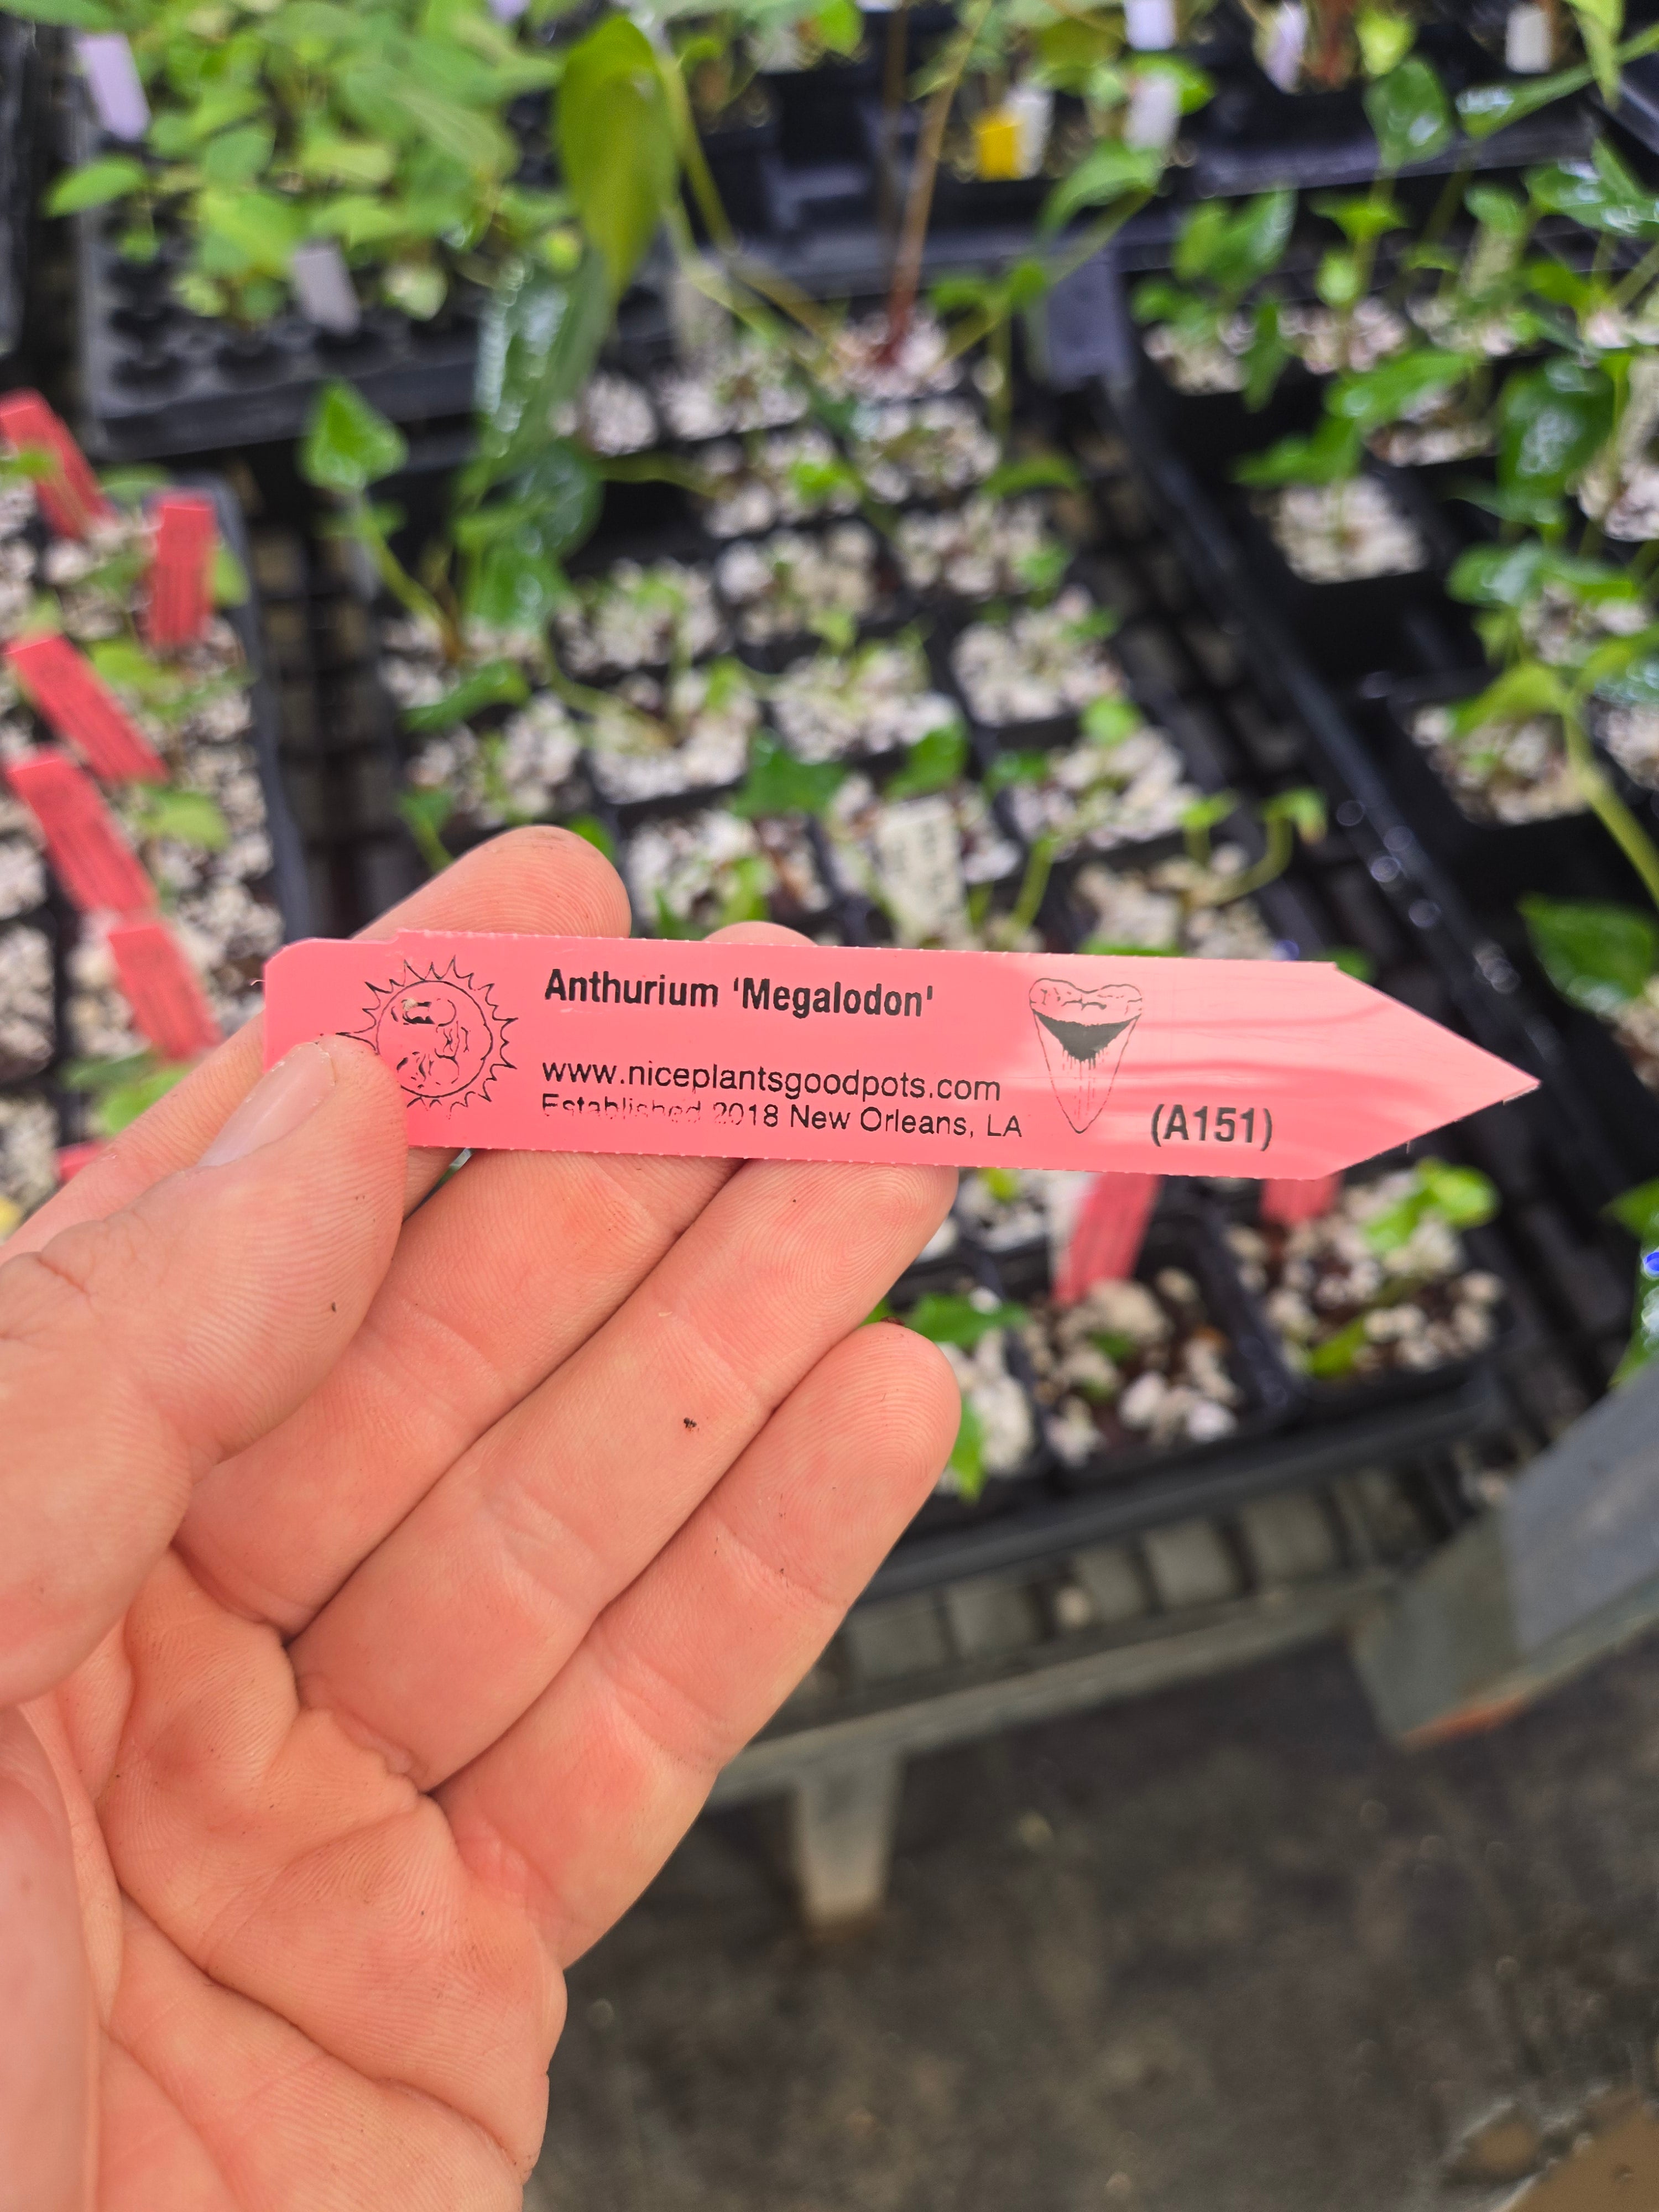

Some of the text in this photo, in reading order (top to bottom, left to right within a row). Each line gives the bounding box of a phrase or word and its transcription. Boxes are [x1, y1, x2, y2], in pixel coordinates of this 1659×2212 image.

[545, 968, 933, 1019] Anthurium 'Megalodon'
[542, 1061, 1001, 1102] www.niceplantsgoodpots.com
[713, 1102, 779, 1128] 2018
[790, 1104, 851, 1130] New
[860, 1106, 974, 1138] Orleans,
[987, 1114, 1022, 1138] LA
[1151, 1104, 1273, 1151] (A151)
